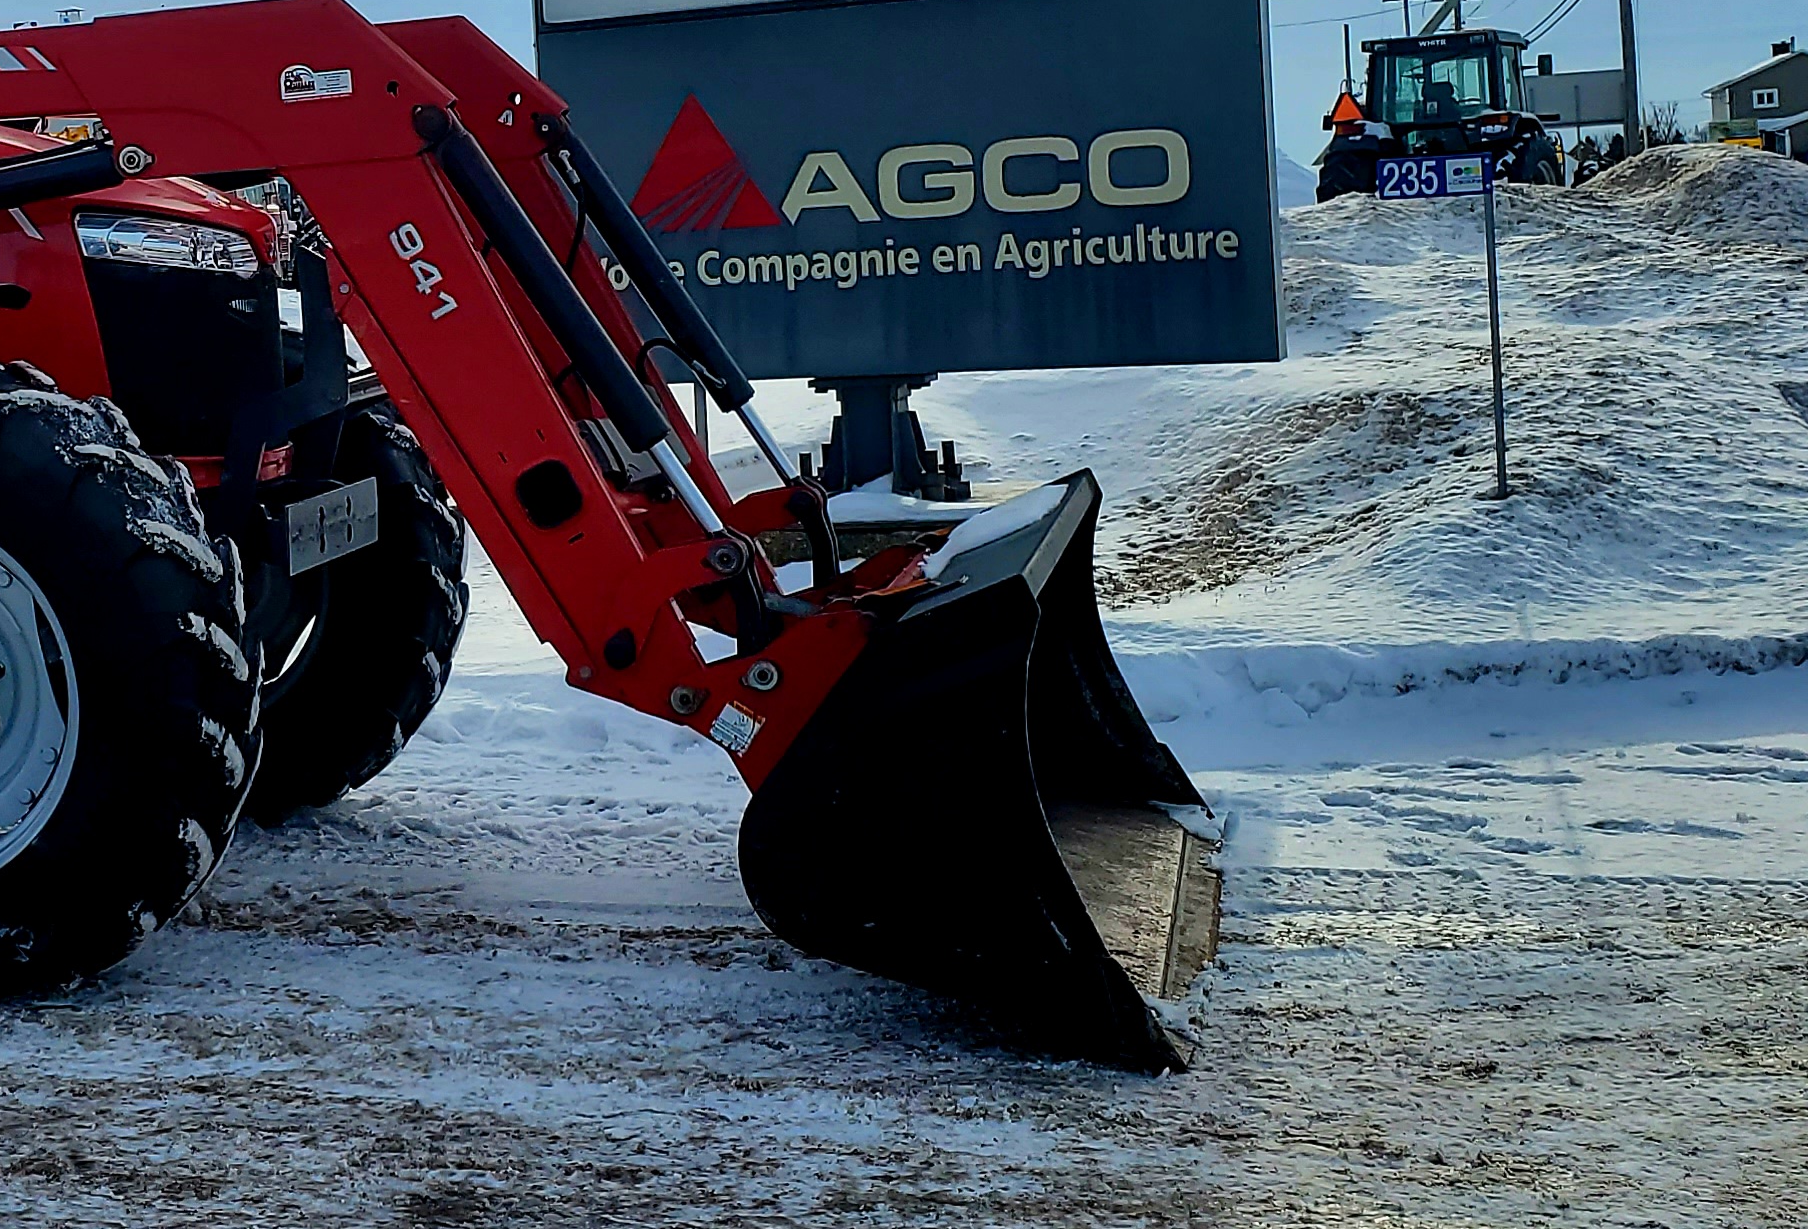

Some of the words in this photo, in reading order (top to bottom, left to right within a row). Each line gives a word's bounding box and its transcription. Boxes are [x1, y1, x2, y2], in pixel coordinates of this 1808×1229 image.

[781, 129, 1190, 226] AGCO
[1383, 161, 1438, 196] 235
[390, 223, 458, 320] 941
[697, 242, 919, 291] Compagnie
[933, 242, 981, 272] en
[994, 223, 1238, 278] Agriculture
